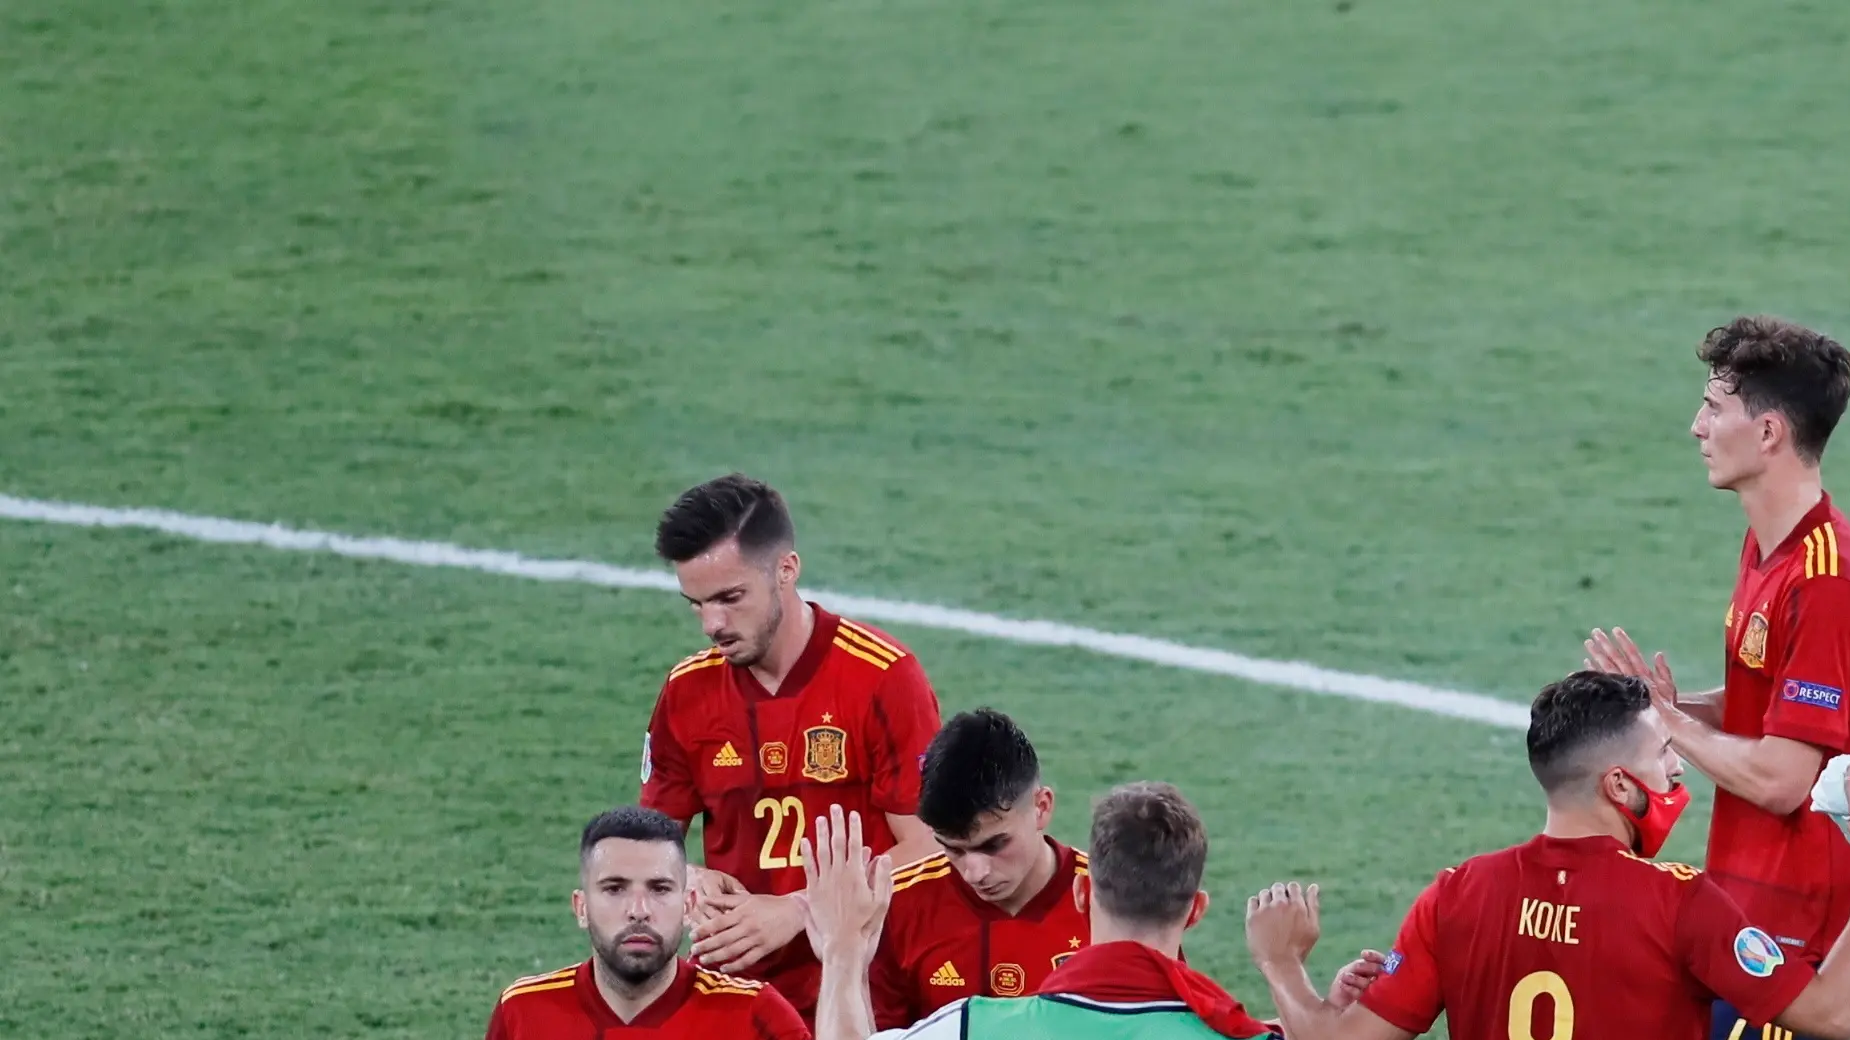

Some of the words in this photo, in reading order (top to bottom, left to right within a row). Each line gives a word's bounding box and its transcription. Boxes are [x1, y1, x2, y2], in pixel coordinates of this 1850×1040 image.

[1799, 687, 1841, 704] RESPECT
[712, 757, 743, 767] adidas
[754, 796, 805, 869] 22
[1518, 897, 1581, 945] KOKE
[929, 976, 965, 987] adidas
